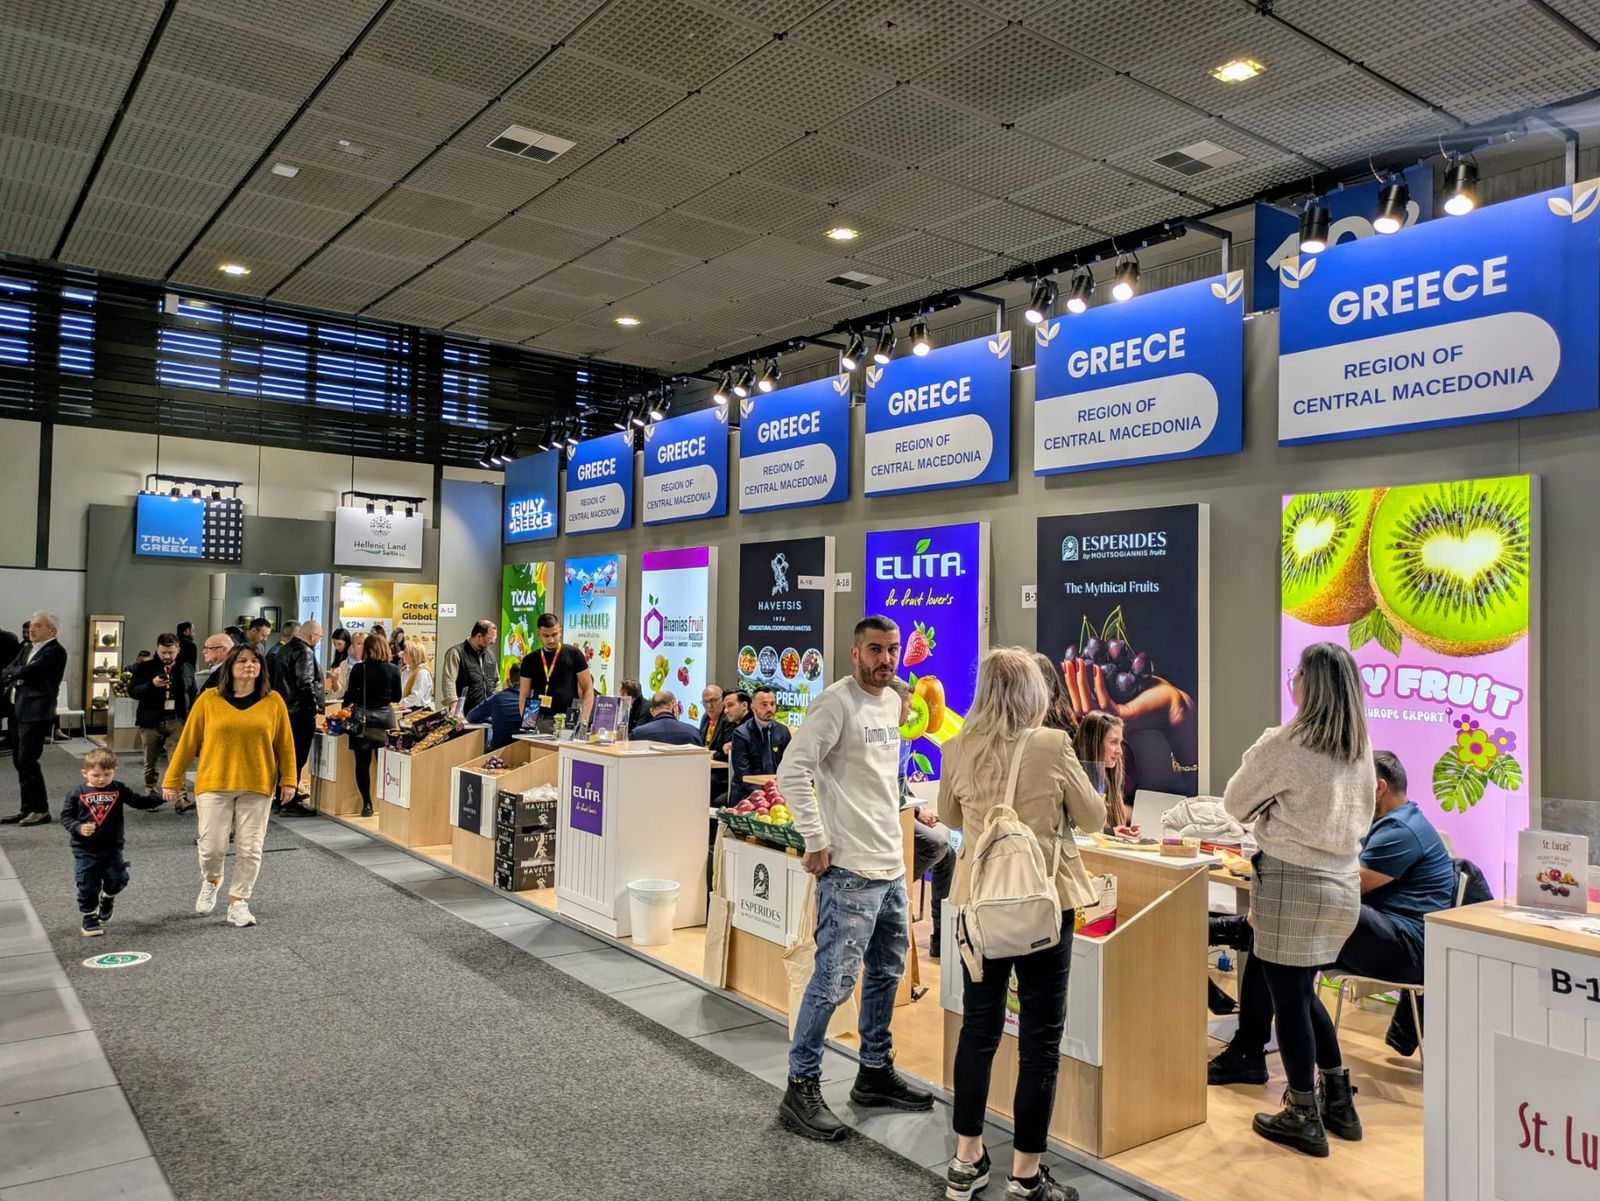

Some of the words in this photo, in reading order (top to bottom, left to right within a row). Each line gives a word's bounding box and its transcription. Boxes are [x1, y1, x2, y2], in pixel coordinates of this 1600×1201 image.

[1328, 255, 1508, 326] GREECE
[1067, 327, 1186, 379] GREECE
[1343, 351, 1425, 380] REGION
[1432, 344, 1464, 365] OF
[888, 376, 971, 416] GREECE
[1292, 388, 1386, 415] CENTRAL
[1391, 365, 1534, 402] MACEDONIA
[1077, 401, 1131, 423] REGION
[1136, 397, 1156, 413] OF
[757, 410, 821, 444] GREECE
[1044, 430, 1105, 451] CENTRAL
[1109, 416, 1201, 442] MACEDONIA
[657, 435, 706, 464] GREECE
[895, 437, 933, 453] REGION
[936, 433, 950, 447] OF
[577, 457, 616, 481] GREECE
[763, 462, 792, 476] REGION
[794, 459, 805, 471] OF
[871, 462, 914, 476] CENTRAL
[917, 450, 982, 470] MACEDONIA
[661, 481, 684, 493] REGION
[685, 478, 694, 488] OF
[744, 483, 778, 496] CENTRAL
[780, 473, 828, 490] MACEDONIA
[510, 498, 544, 517] TRULY
[580, 497, 599, 507] REGION
[599, 495, 606, 504] OF
[646, 498, 673, 510] CENTRAL
[674, 491, 711, 506] MACEDONIA
[510, 512, 552, 534] GREECE
[568, 512, 589, 522] CENTRAL
[590, 507, 620, 518] MACEDONIA
[140, 544, 198, 554] GREECE
[141, 535, 189, 544] TRULY
[353, 540, 385, 549] Hellenic
[387, 543, 406, 551] Land
[1082, 531, 1167, 551] ESPERIDES
[1082, 552, 1090, 560] by
[1091, 550, 1148, 559] MOUTSOGIANNIS
[1149, 549, 1166, 557] fruits
[836, 578, 849, 587] A-18
[1065, 582, 1083, 594] The
[1084, 581, 1127, 596] Mythical
[1129, 580, 1159, 593] Fruits
[402, 602, 429, 610] Greek
[758, 600, 802, 610] HAVETSIS
[885, 588, 898, 607] for
[901, 588, 924, 607] fruit
[926, 587, 954, 606] lover's
[402, 612, 432, 621] Global
[1402, 708, 1445, 723] EXPORT
[86, 795, 113, 803] GUESS
[573, 786, 600, 802] ELITA
[741, 899, 780, 921] ESPERIDES
[1518, 1101, 1555, 1157] St.
